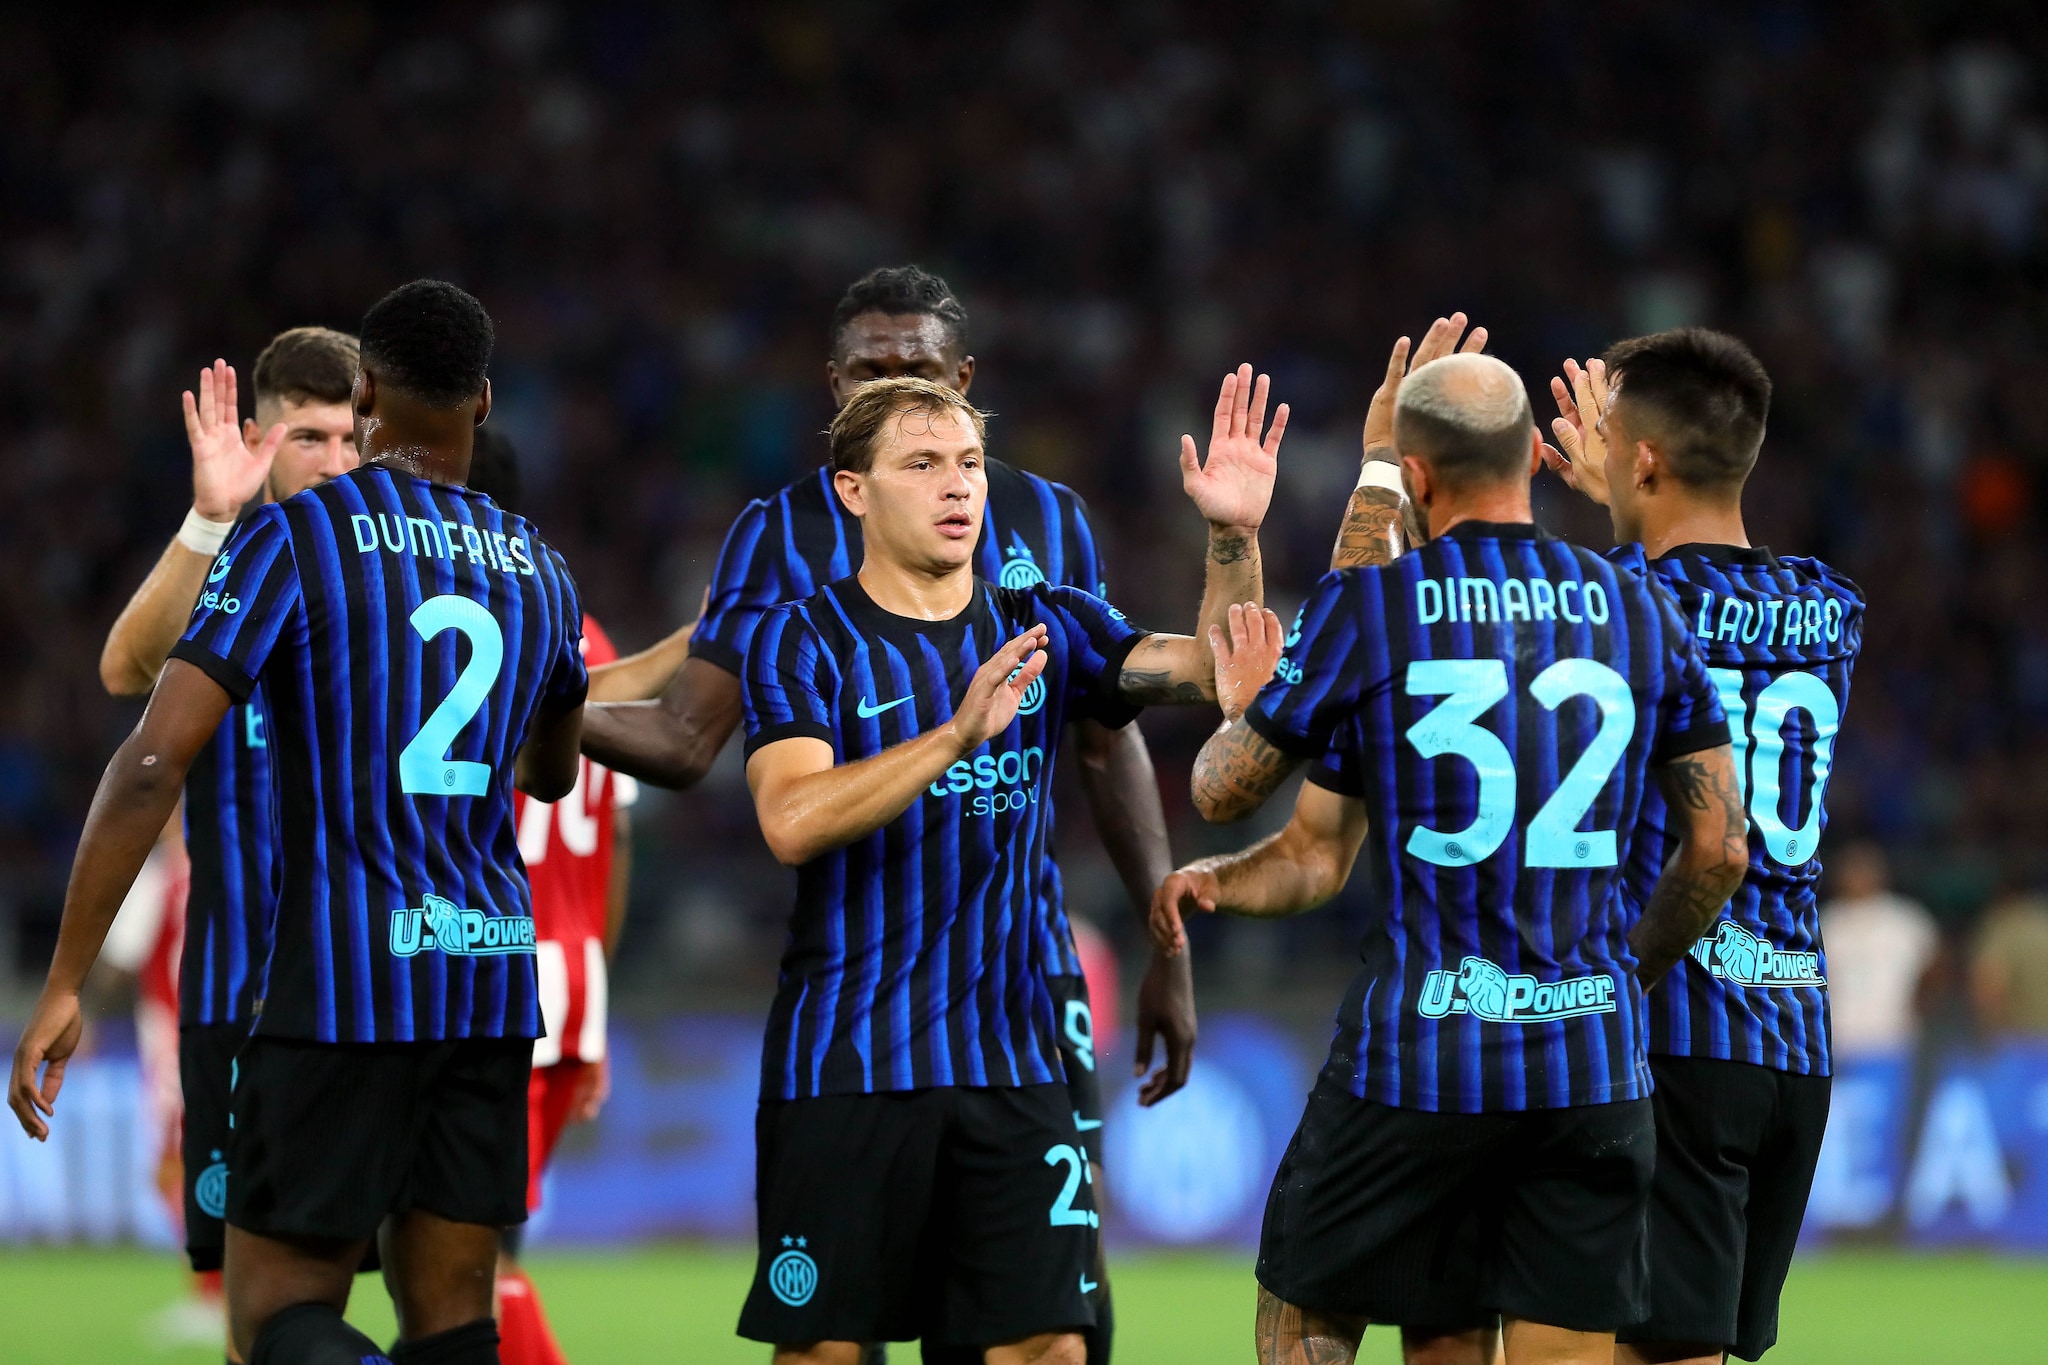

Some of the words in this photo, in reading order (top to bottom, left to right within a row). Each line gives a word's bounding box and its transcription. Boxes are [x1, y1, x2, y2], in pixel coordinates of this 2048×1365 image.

[350, 513, 535, 576] DUMFRIES
[1415, 576, 1610, 626] DIMARCO
[1697, 592, 1842, 646] LAUTARO
[399, 594, 504, 797] 2
[1405, 656, 1638, 868] 32
